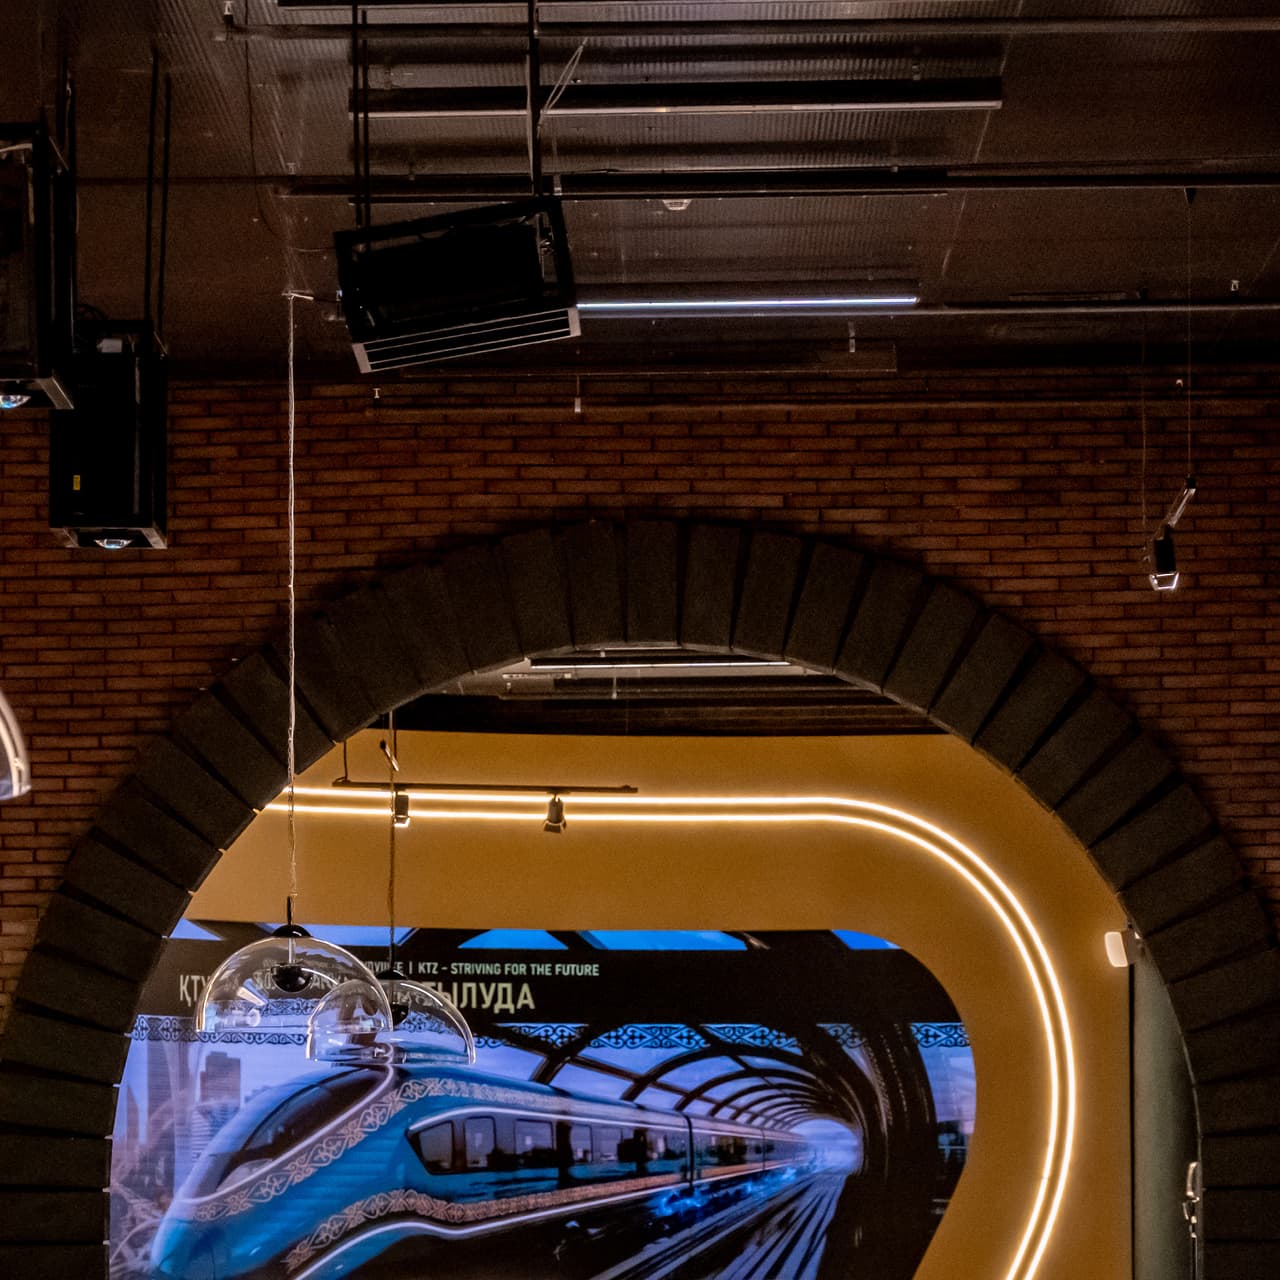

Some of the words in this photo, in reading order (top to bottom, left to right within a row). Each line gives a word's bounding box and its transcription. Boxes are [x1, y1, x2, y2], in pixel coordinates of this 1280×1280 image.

[418, 962, 438, 974] KTZ
[451, 962, 501, 975] STRIVING
[504, 963, 526, 976] FOR
[530, 963, 552, 976] THE
[555, 963, 599, 976] FUTURE
